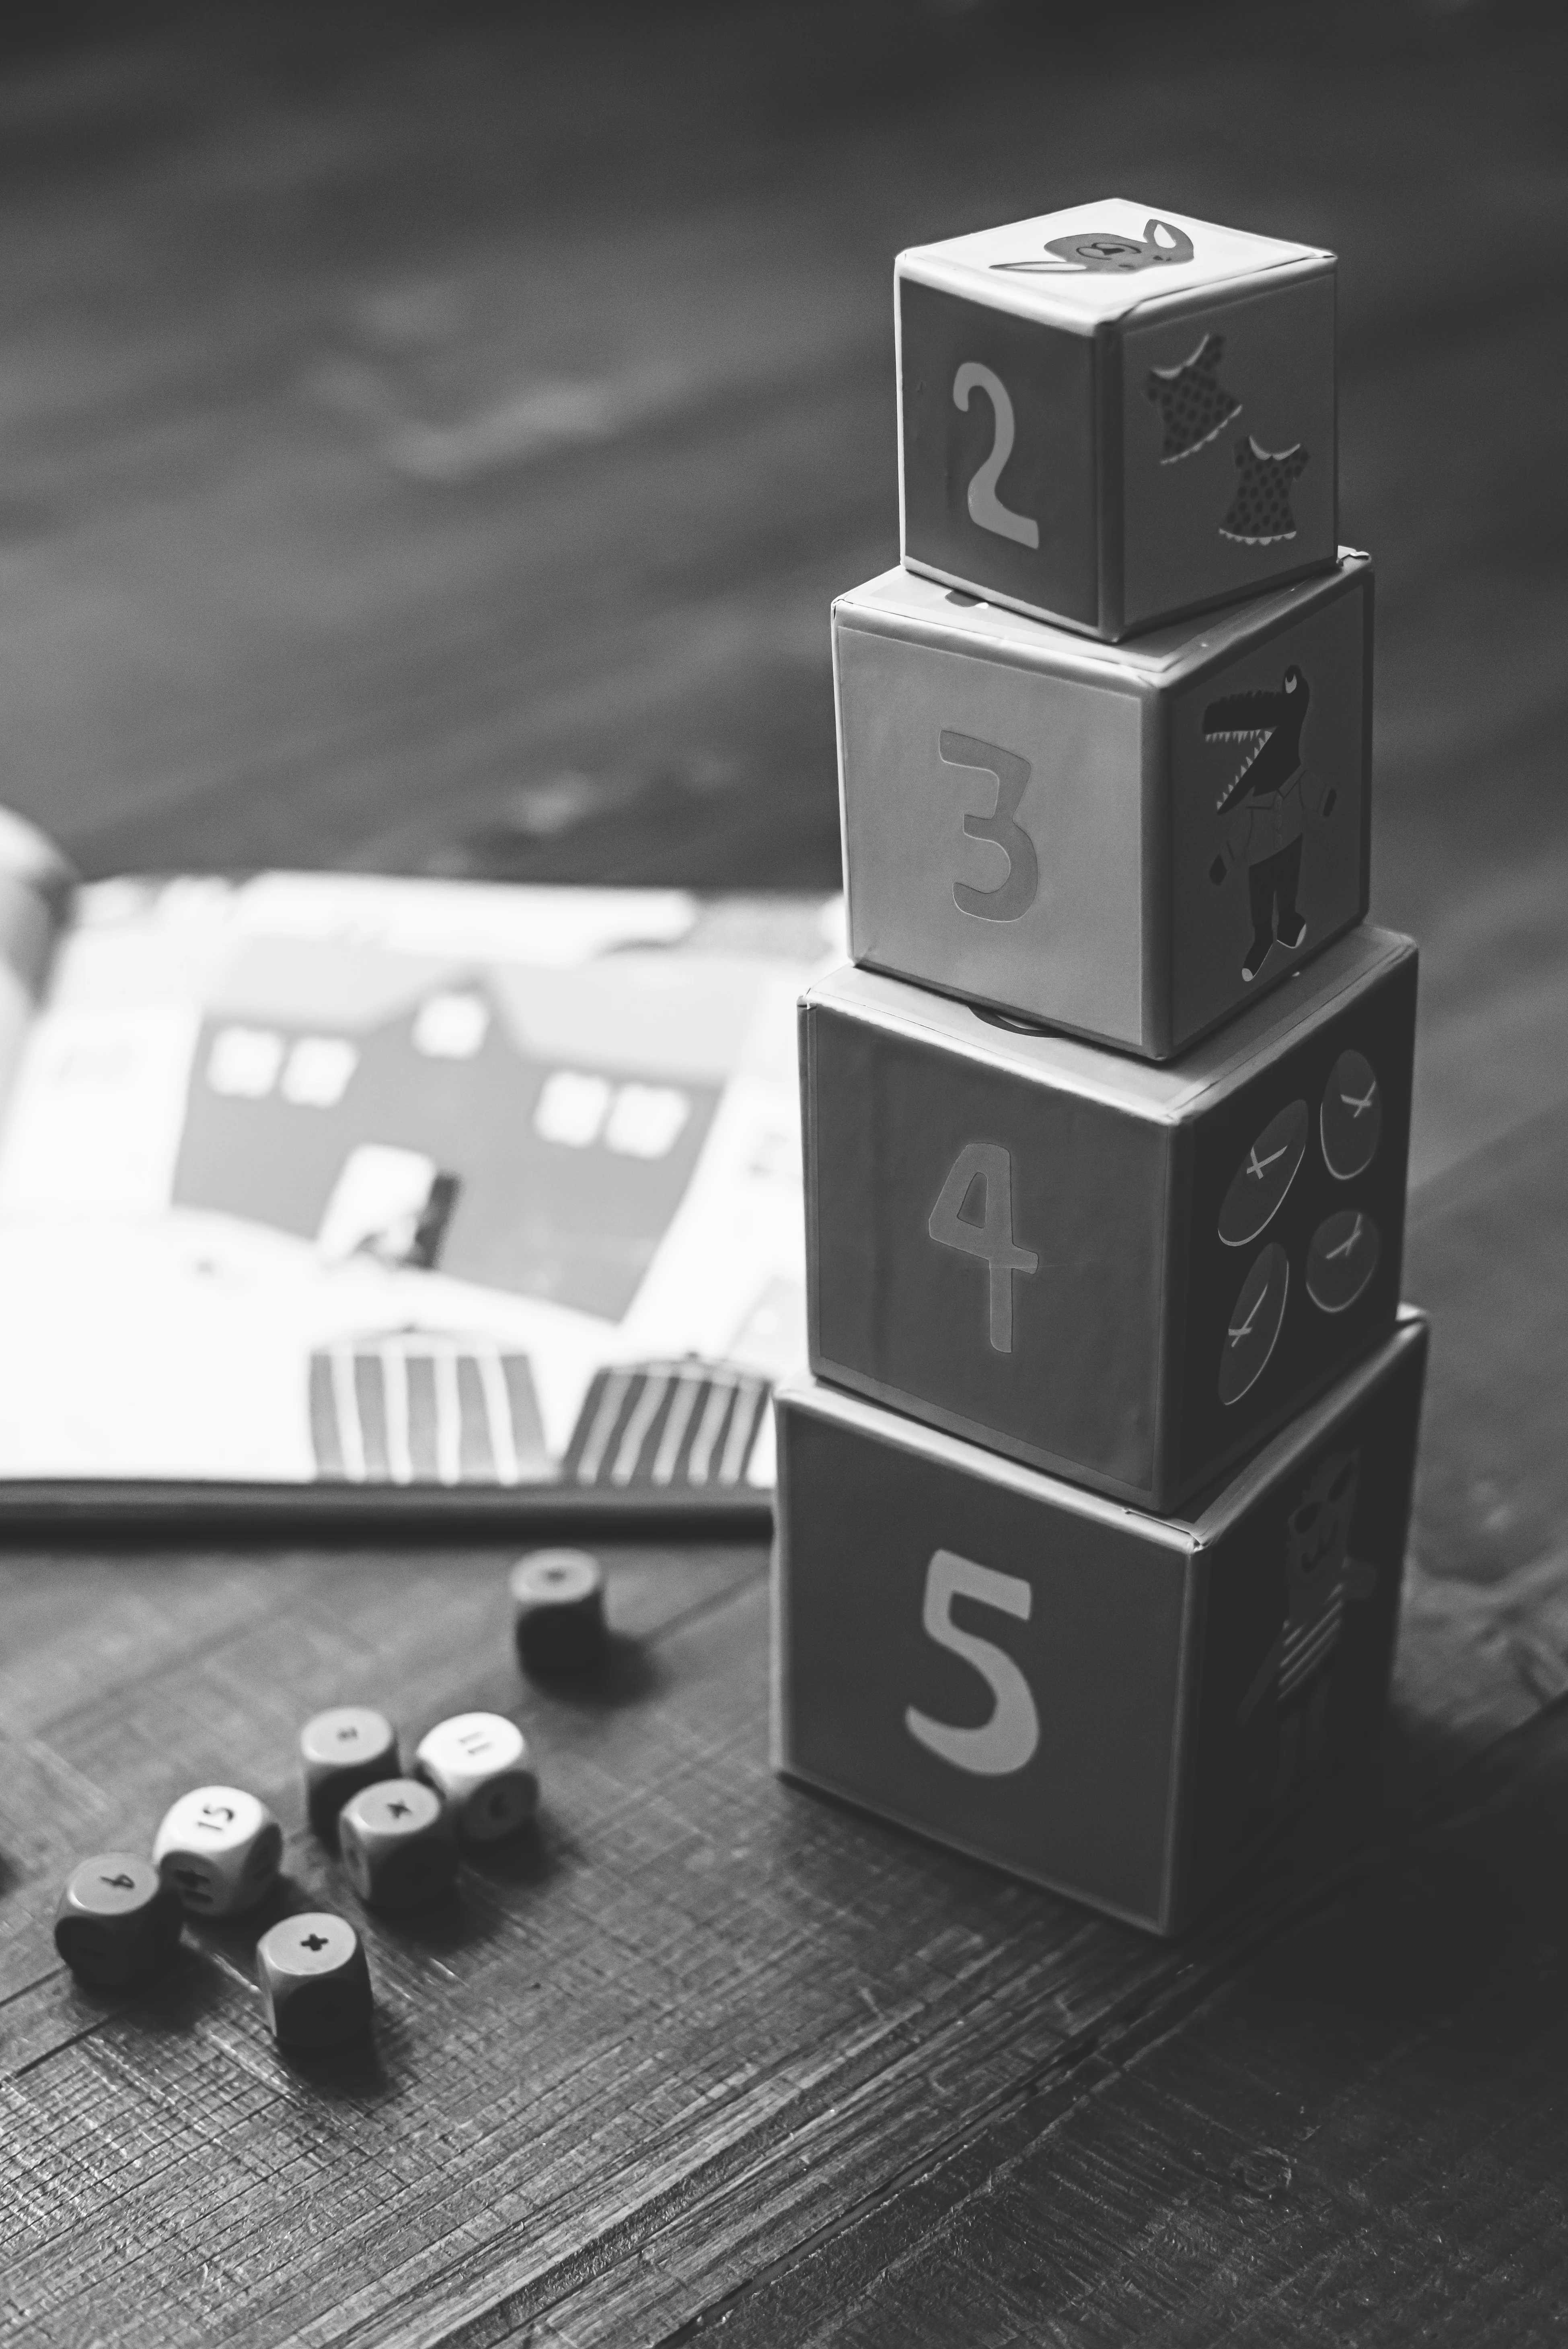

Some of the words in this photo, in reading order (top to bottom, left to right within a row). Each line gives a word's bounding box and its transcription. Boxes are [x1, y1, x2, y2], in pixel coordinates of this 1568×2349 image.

[953, 361, 1040, 549] 2
[939, 730, 1038, 922] 3
[928, 1143, 1039, 1353] 4
[904, 1548, 1042, 1778] 5
[101, 1873, 136, 1890] 4
[196, 1803, 234, 1831] 15
